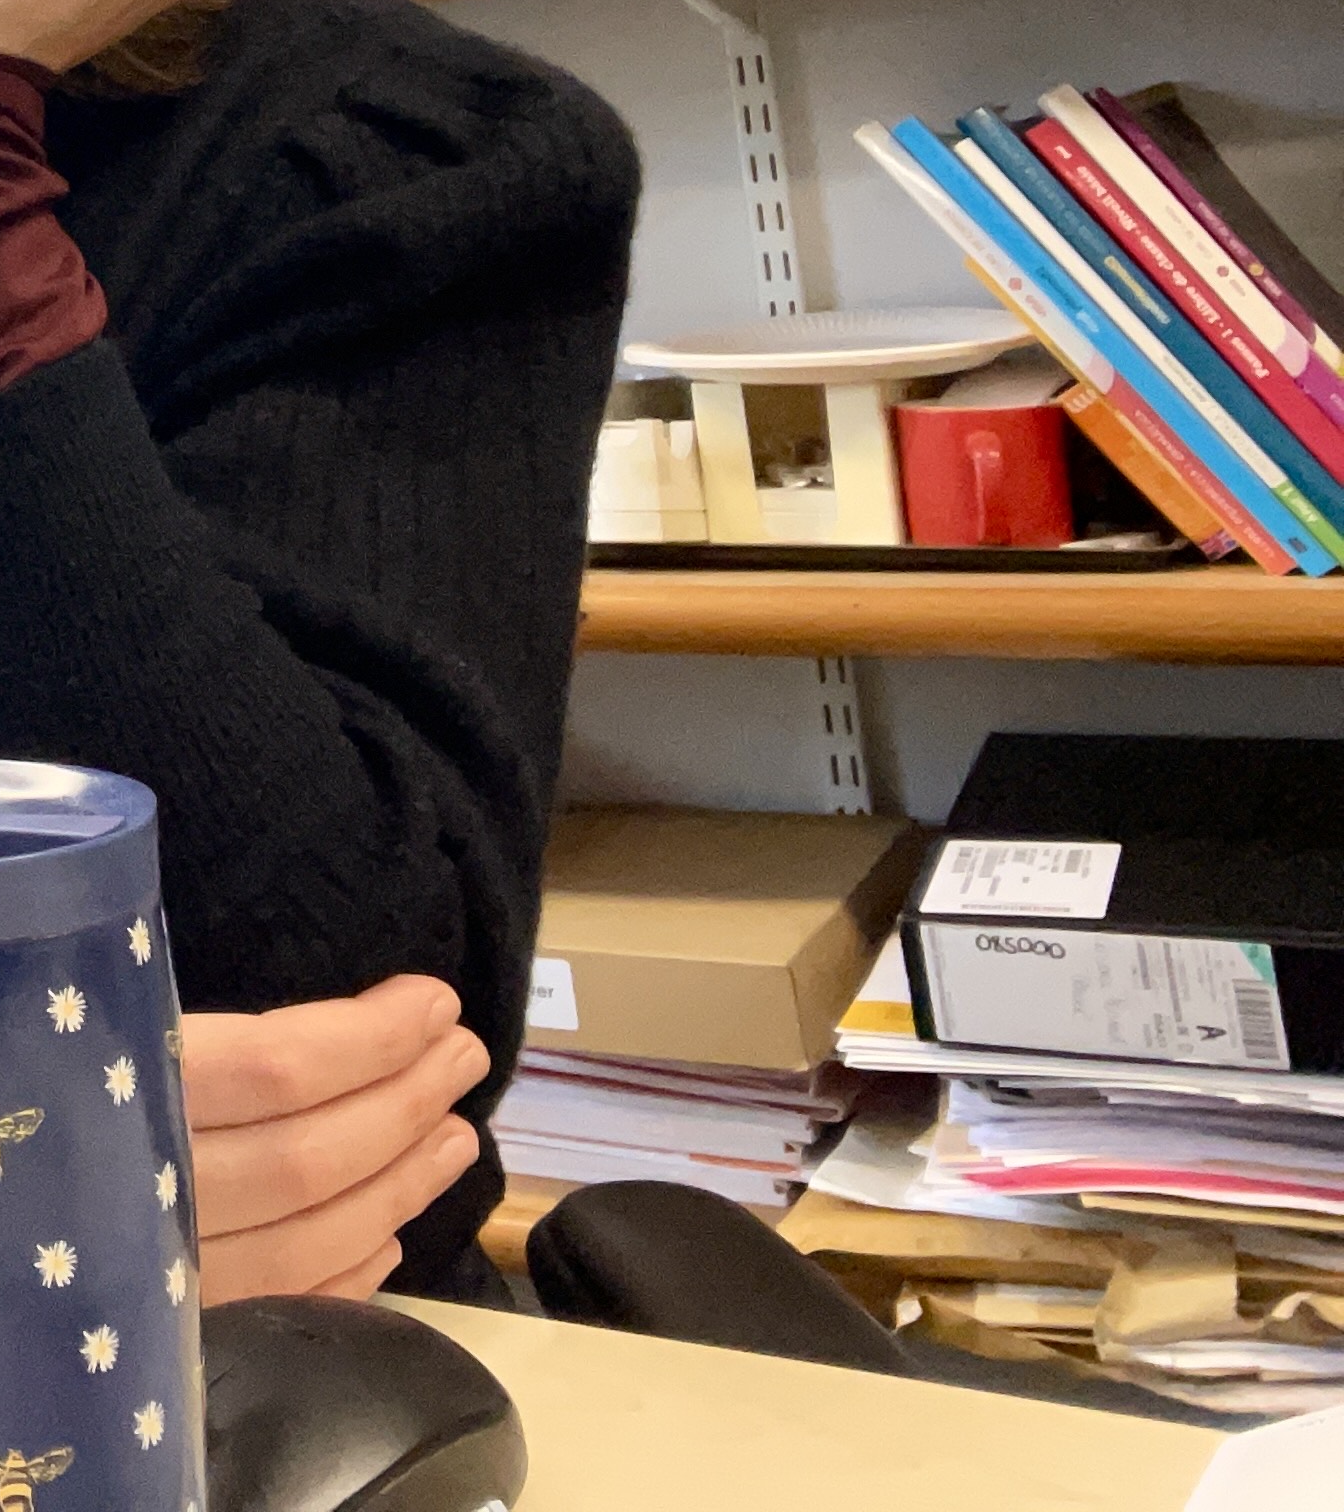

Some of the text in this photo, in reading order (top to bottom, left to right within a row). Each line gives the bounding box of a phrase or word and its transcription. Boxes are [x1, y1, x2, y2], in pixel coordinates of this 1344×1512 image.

[1140, 235, 1174, 270] classe
[1172, 271, 1188, 286] de
[1186, 286, 1221, 324] Llibre
